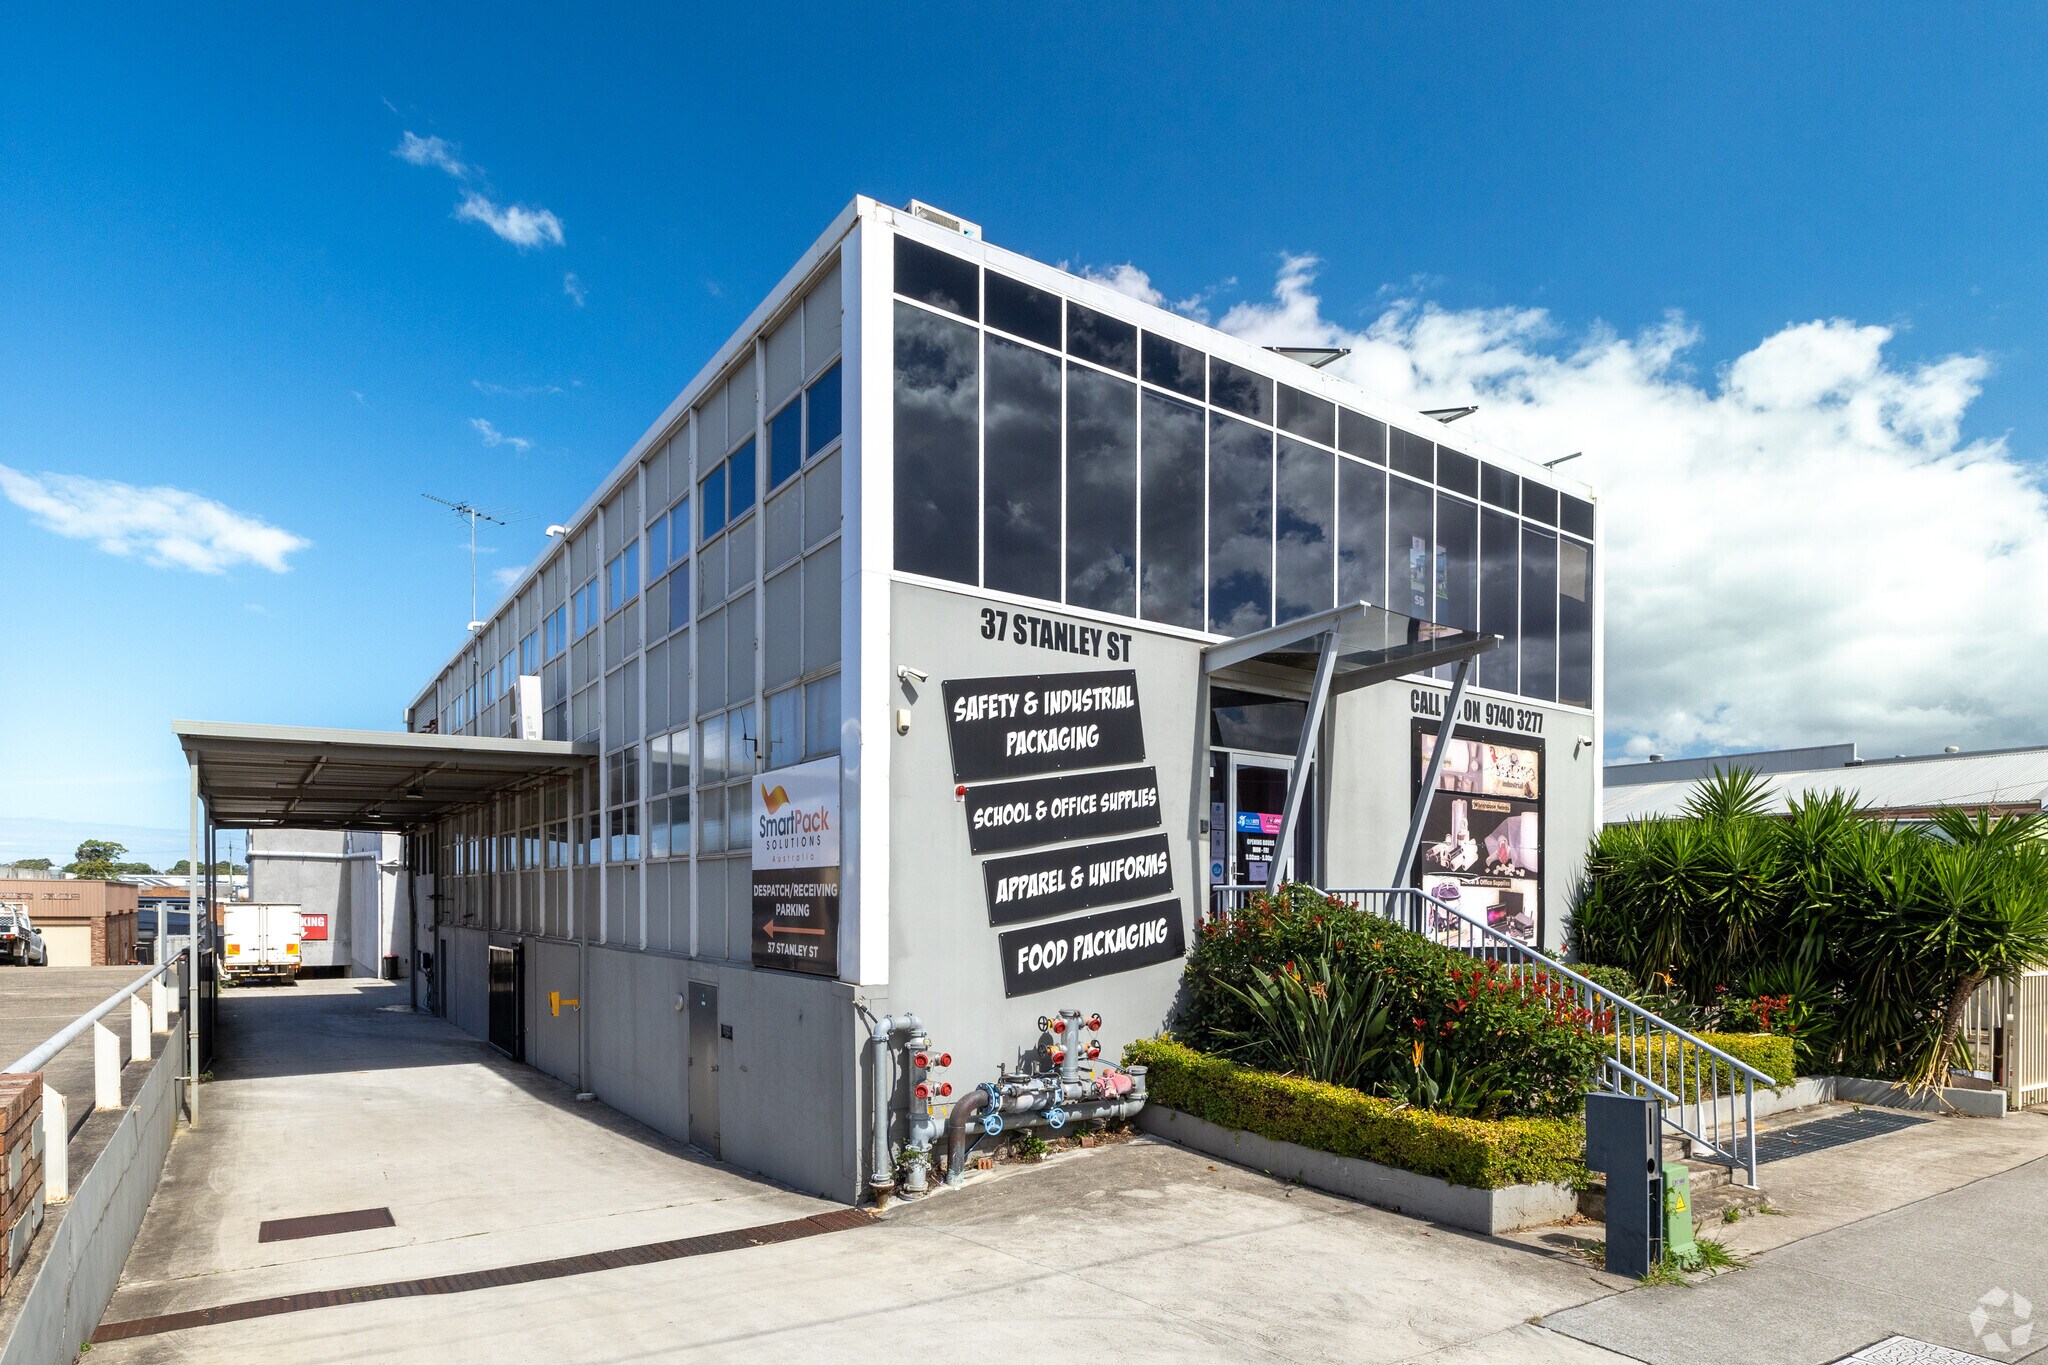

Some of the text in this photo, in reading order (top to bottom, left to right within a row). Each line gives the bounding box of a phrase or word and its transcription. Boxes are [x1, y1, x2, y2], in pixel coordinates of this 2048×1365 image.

[980, 608, 1132, 663] 37 STANLEY ST
[954, 684, 1135, 722] SAFETY & INDUSTRIAL
[1410, 689, 1441, 717] CALL
[1464, 698, 1481, 723] ON
[1485, 702, 1515, 729] 9740
[1516, 708, 1544, 734] 3277
[1005, 724, 1100, 757] PACKAGING
[759, 805, 829, 839] SmartPack
[973, 787, 1157, 830] SCHOOL & OFFICE SUPPLIES
[766, 835, 821, 851] SOLUTIONS
[772, 853, 815, 863] Australia
[753, 882, 838, 899] DESPATCH/RECEIVING
[995, 851, 1168, 905] APPAREL & UNIFORMS
[301, 916, 325, 927] KING
[775, 903, 810, 917] PARKING
[767, 941, 819, 958] 37 STANLEY ST
[1017, 917, 1168, 974] FOOD PACKAGING
